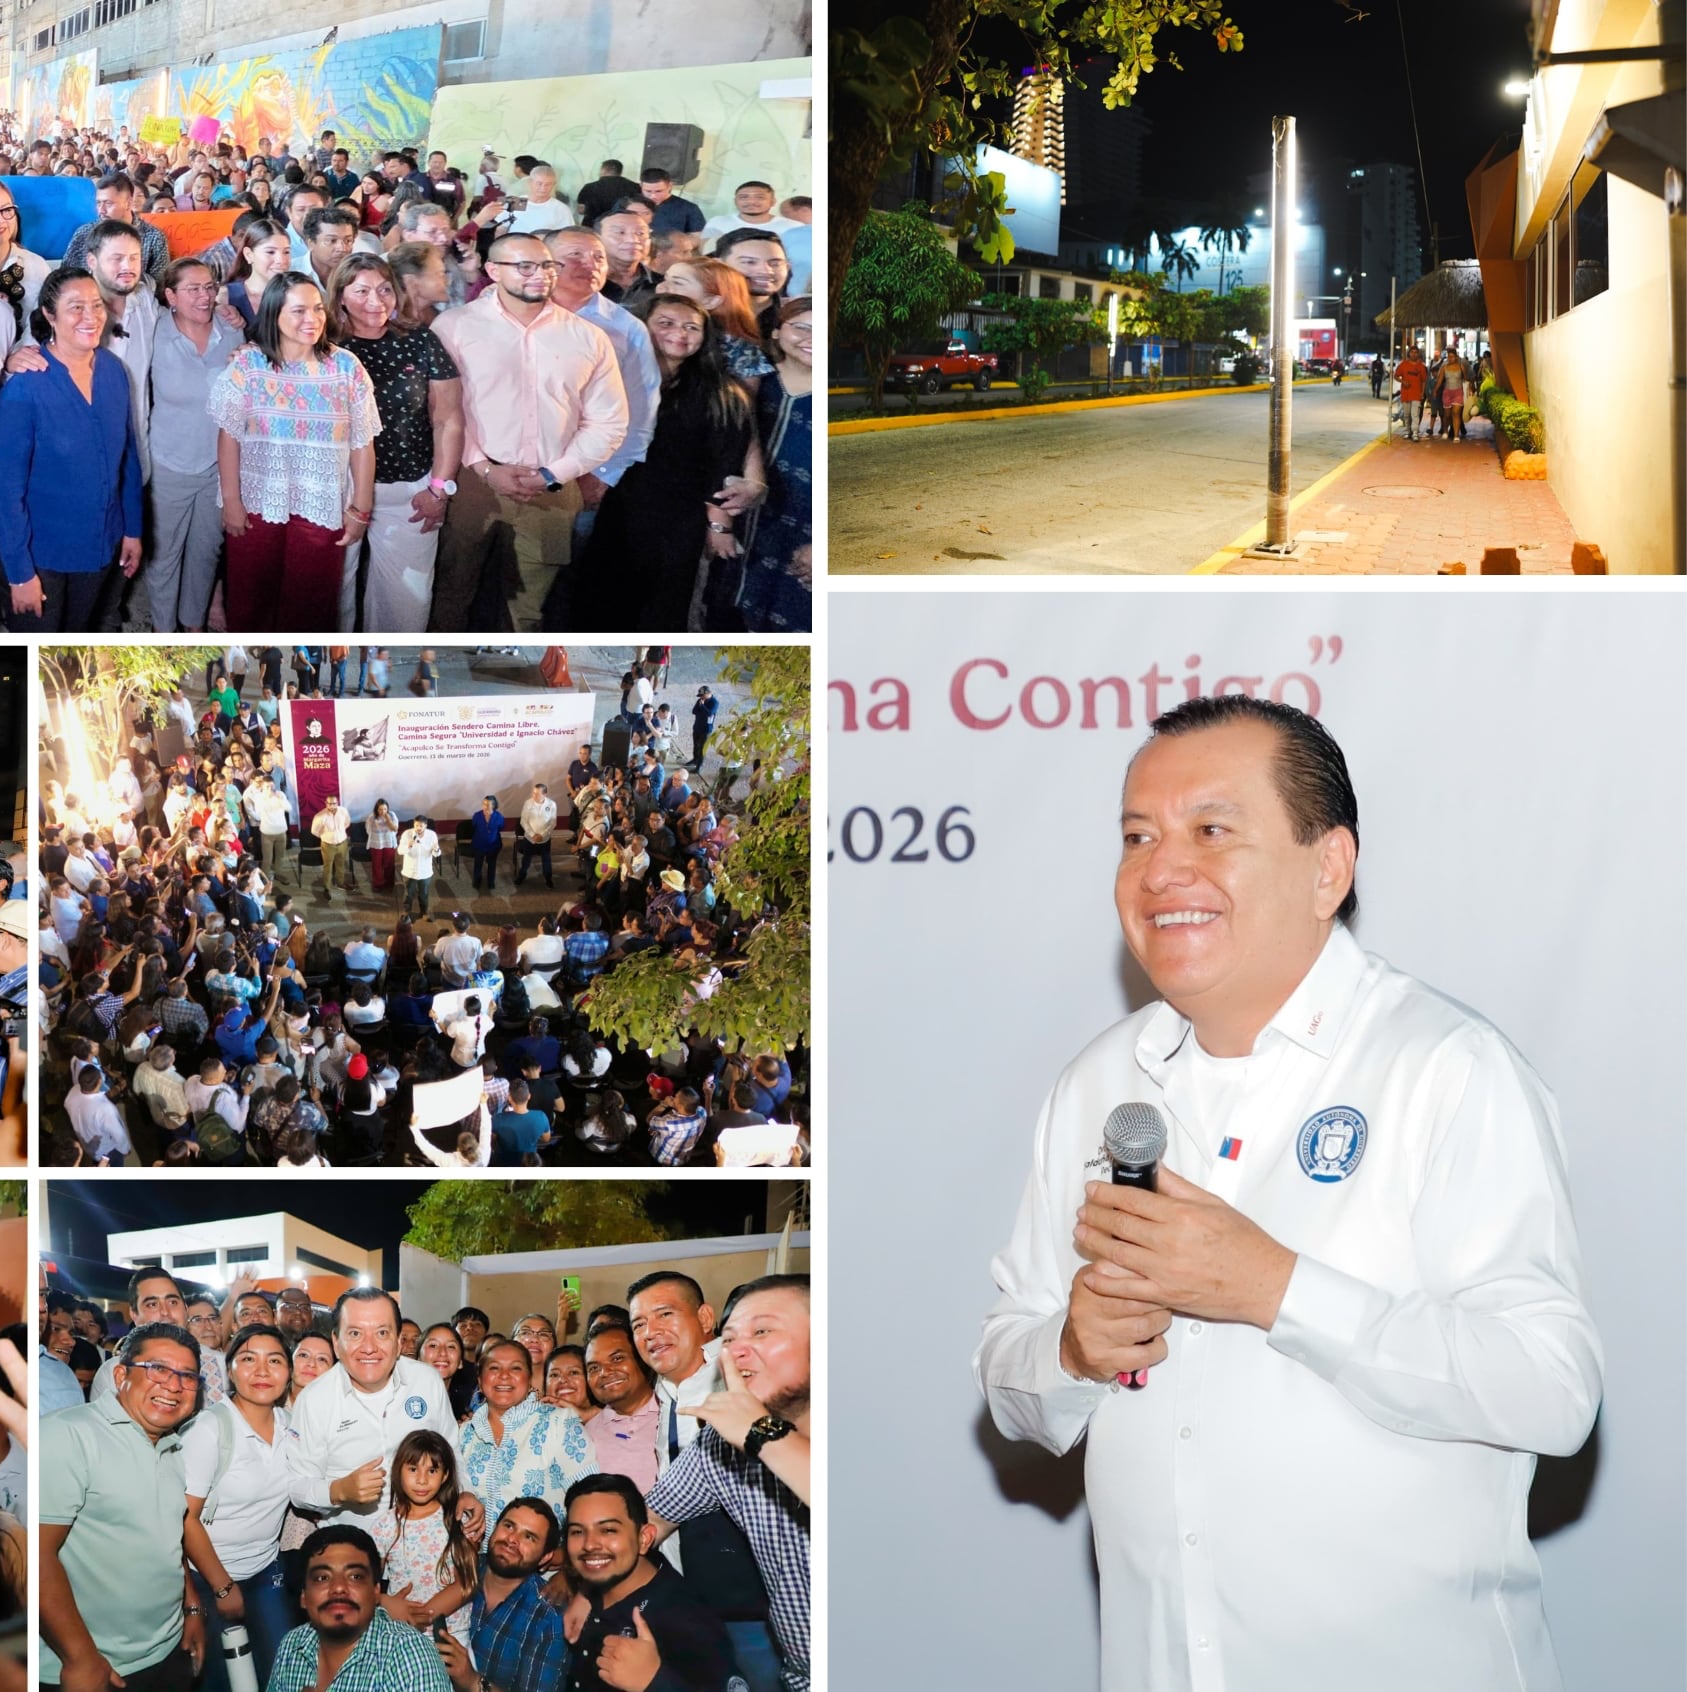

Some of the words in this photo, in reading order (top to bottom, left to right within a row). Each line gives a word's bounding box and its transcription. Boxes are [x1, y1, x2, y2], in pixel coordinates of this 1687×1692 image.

[1206, 255, 1240, 267] COSERA
[398, 724, 449, 733] Inauguración
[452, 723, 484, 731] Sendero
[486, 722, 515, 730] Camina
[398, 733, 428, 741] Camina
[430, 732, 457, 741] Segura
[517, 729, 544, 739] Ignacio
[302, 745, 330, 754] 2026
[447, 742, 486, 750] Transforma
[827, 805, 976, 864] 026
